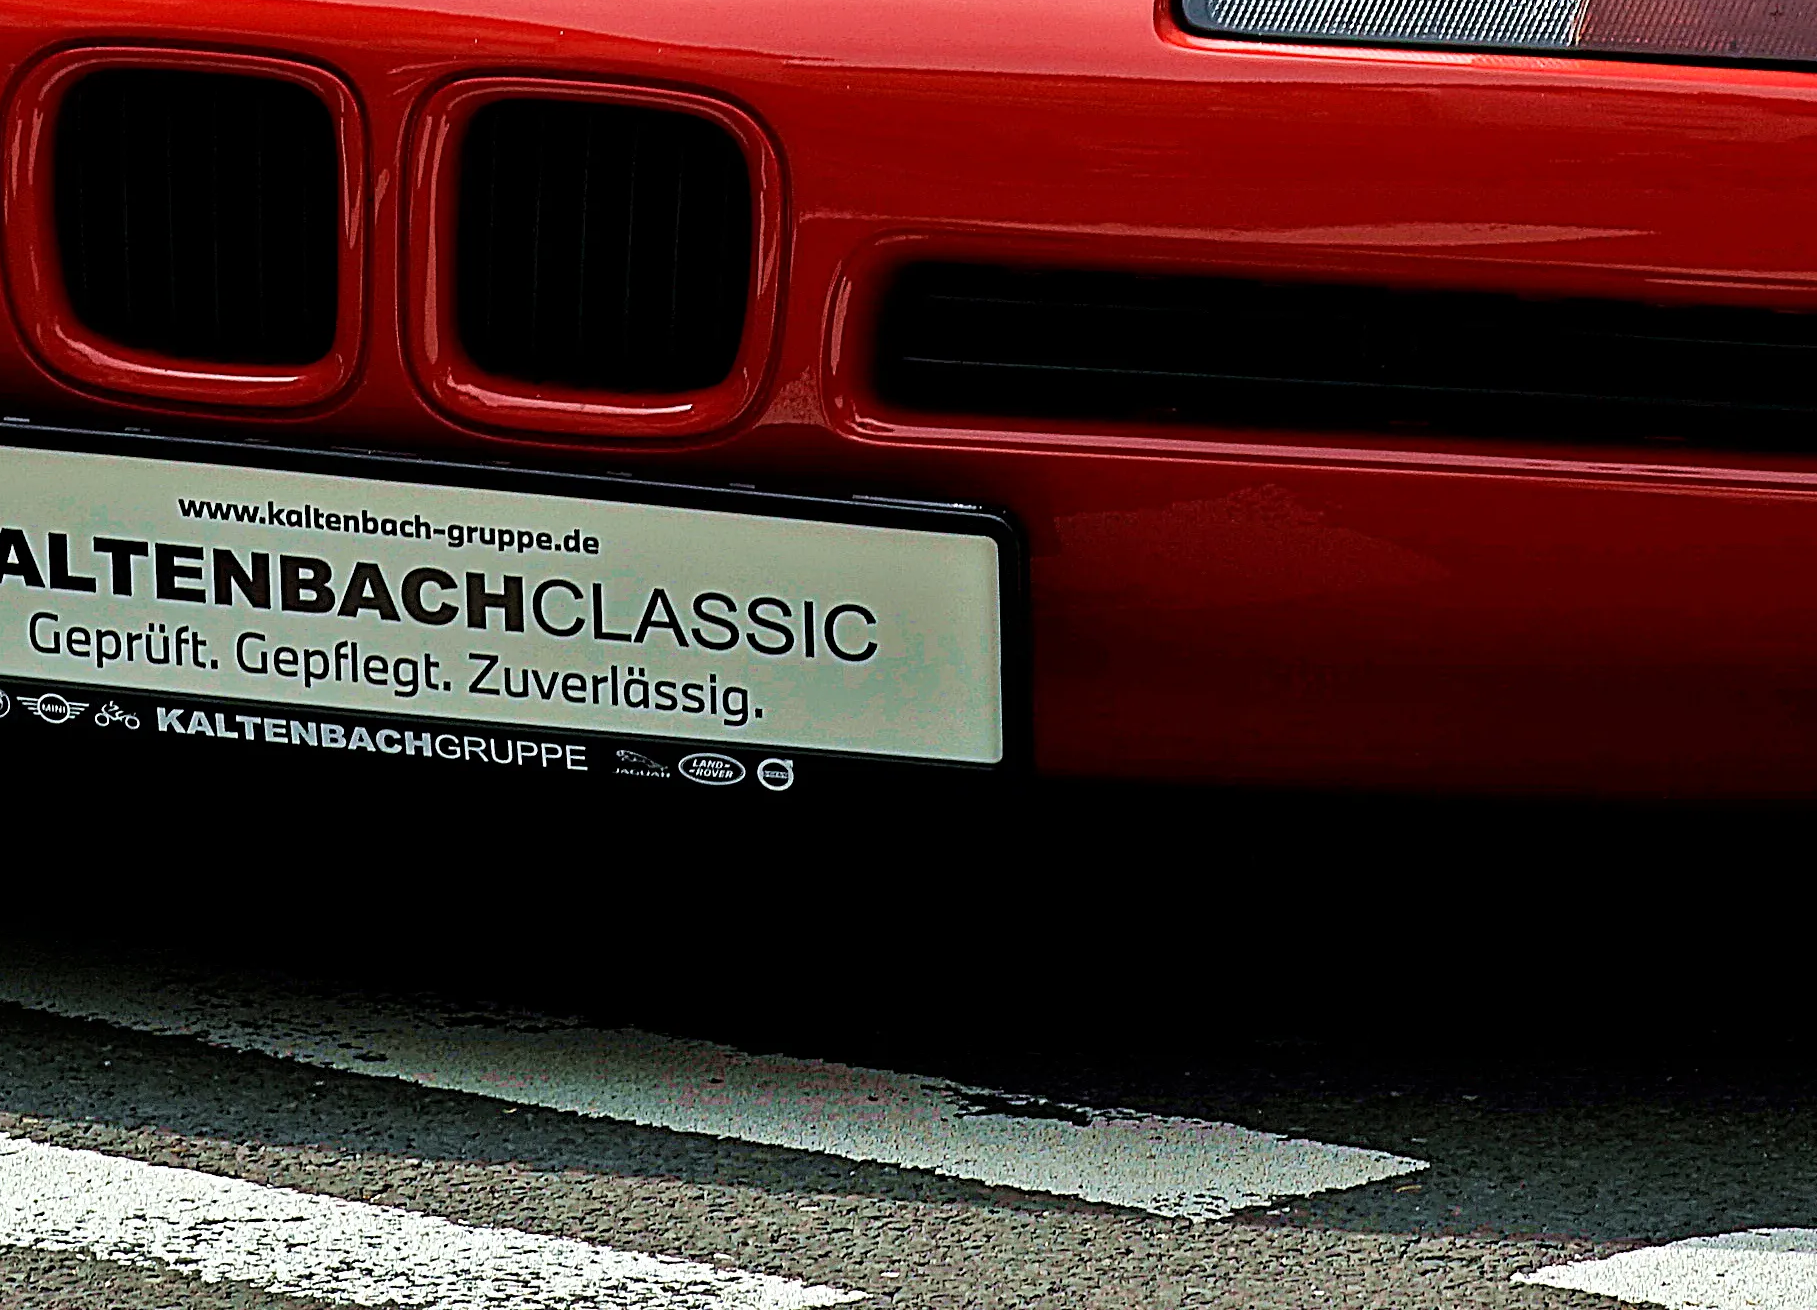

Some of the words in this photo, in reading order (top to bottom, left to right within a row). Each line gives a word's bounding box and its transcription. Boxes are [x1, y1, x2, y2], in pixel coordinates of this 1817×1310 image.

[178, 497, 600, 555] www.kaltenbach-gruppe.de
[28, 611, 220, 669] Geprüft.
[235, 631, 452, 698] Gepflegt.
[467, 651, 765, 726] Zuverlässig.
[156, 706, 590, 772] KALTENBACHGRUPPE
